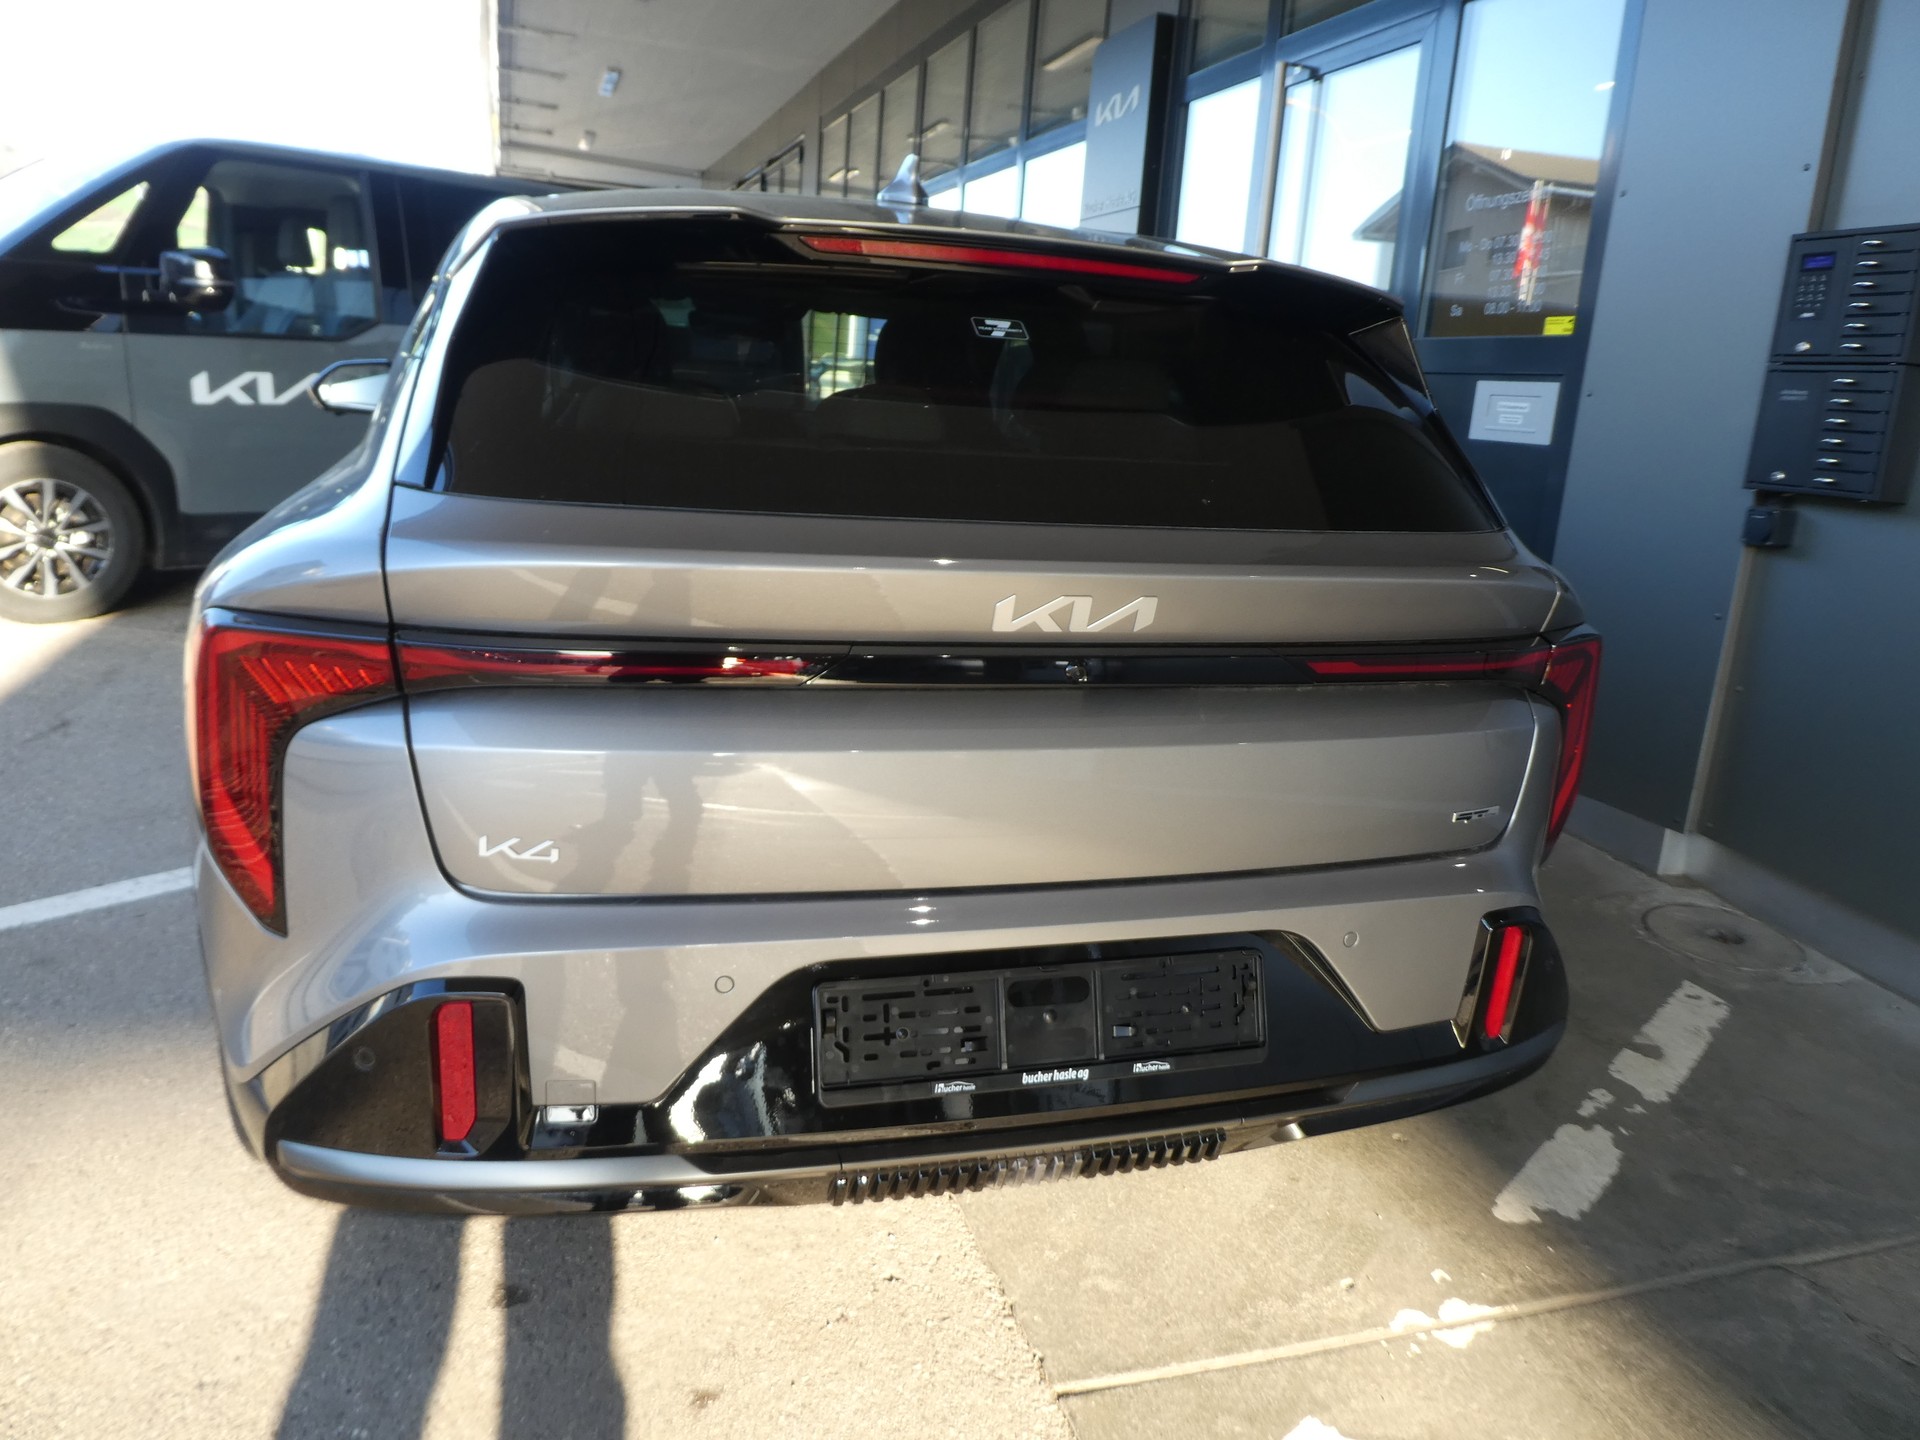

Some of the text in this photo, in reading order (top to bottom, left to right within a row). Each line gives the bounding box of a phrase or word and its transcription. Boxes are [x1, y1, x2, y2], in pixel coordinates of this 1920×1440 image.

[1095, 84, 1140, 127] KIA
[992, 594, 1158, 632] KIA
[1022, 1068, 1090, 1084] bucher hasle ag
